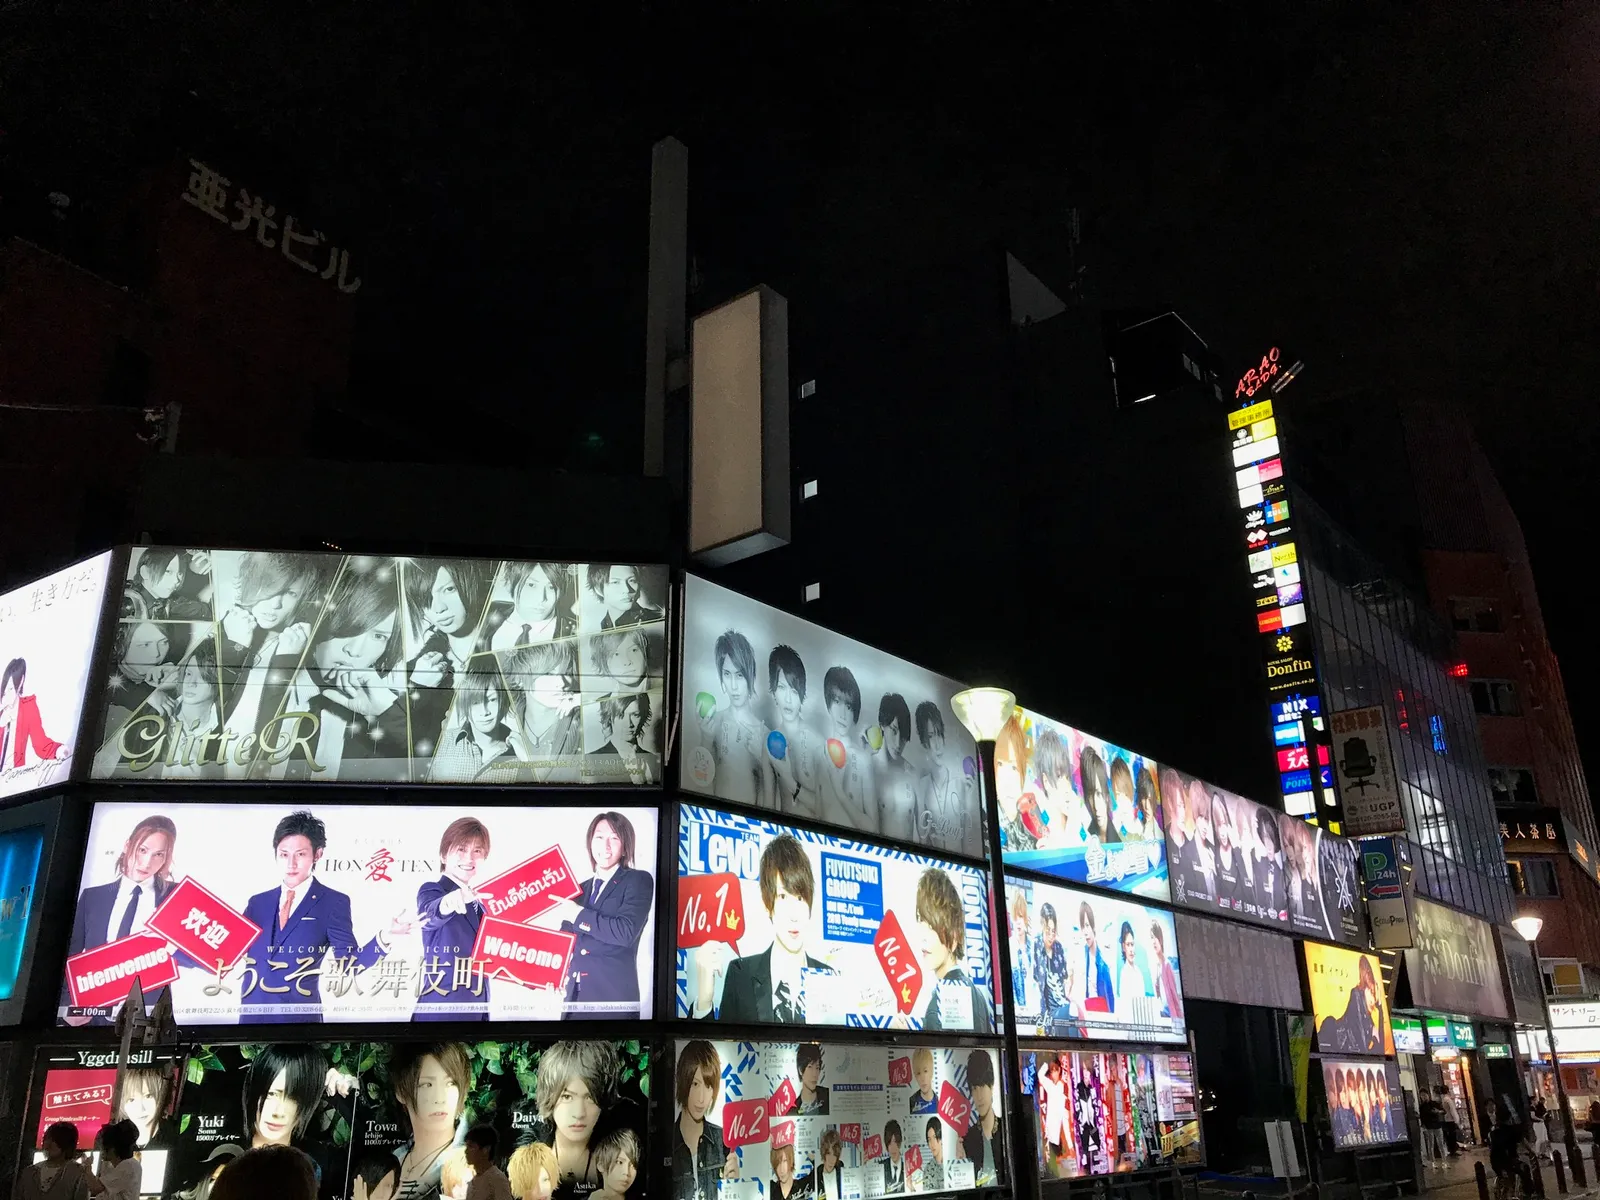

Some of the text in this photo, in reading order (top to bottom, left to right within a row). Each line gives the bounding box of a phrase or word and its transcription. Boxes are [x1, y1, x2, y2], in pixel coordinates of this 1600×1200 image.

[181, 158, 361, 293] 亜光ビル
[1235, 346, 1280, 398] ARAO
[1267, 660, 1312, 678] Donfin
[1282, 698, 1309, 713] NIX
[117, 711, 327, 773] GlitteR
[1369, 802, 1396, 813] UGP
[741, 832, 760, 842] TEAM
[1499, 821, 1557, 840] 美人茶屋
[325, 859, 363, 872] HON
[365, 847, 395, 883] 愛
[397, 859, 435, 872] TEN
[825, 857, 879, 885] FUYUTSUKI
[1364, 852, 1388, 881] P
[1377, 870, 1397, 880] 24h
[487, 866, 567, 915] ยินดีต้อนรับ
[825, 878, 860, 901] GROUP
[681, 882, 729, 936] No.1
[181, 907, 231, 950] 欢迎
[483, 935, 564, 970] Welcome
[879, 937, 917, 984] No.1
[76, 947, 169, 993] bienvenue
[202, 954, 526, 998] ようこそ歌舞伎町へ
[82, 1007, 107, 1017] 100m
[1552, 1007, 1596, 1017] サントリー
[775, 1085, 791, 1117] No.3
[941, 1096, 968, 1125] No.2
[197, 1115, 225, 1128] Yuki
[365, 1120, 398, 1132] Towa
[513, 1111, 545, 1126] Daiya
[727, 1104, 765, 1139] No.2
[364, 1132, 383, 1140] Ichijo
[775, 1123, 791, 1145] No.4
[573, 1181, 597, 1190] Asuka
